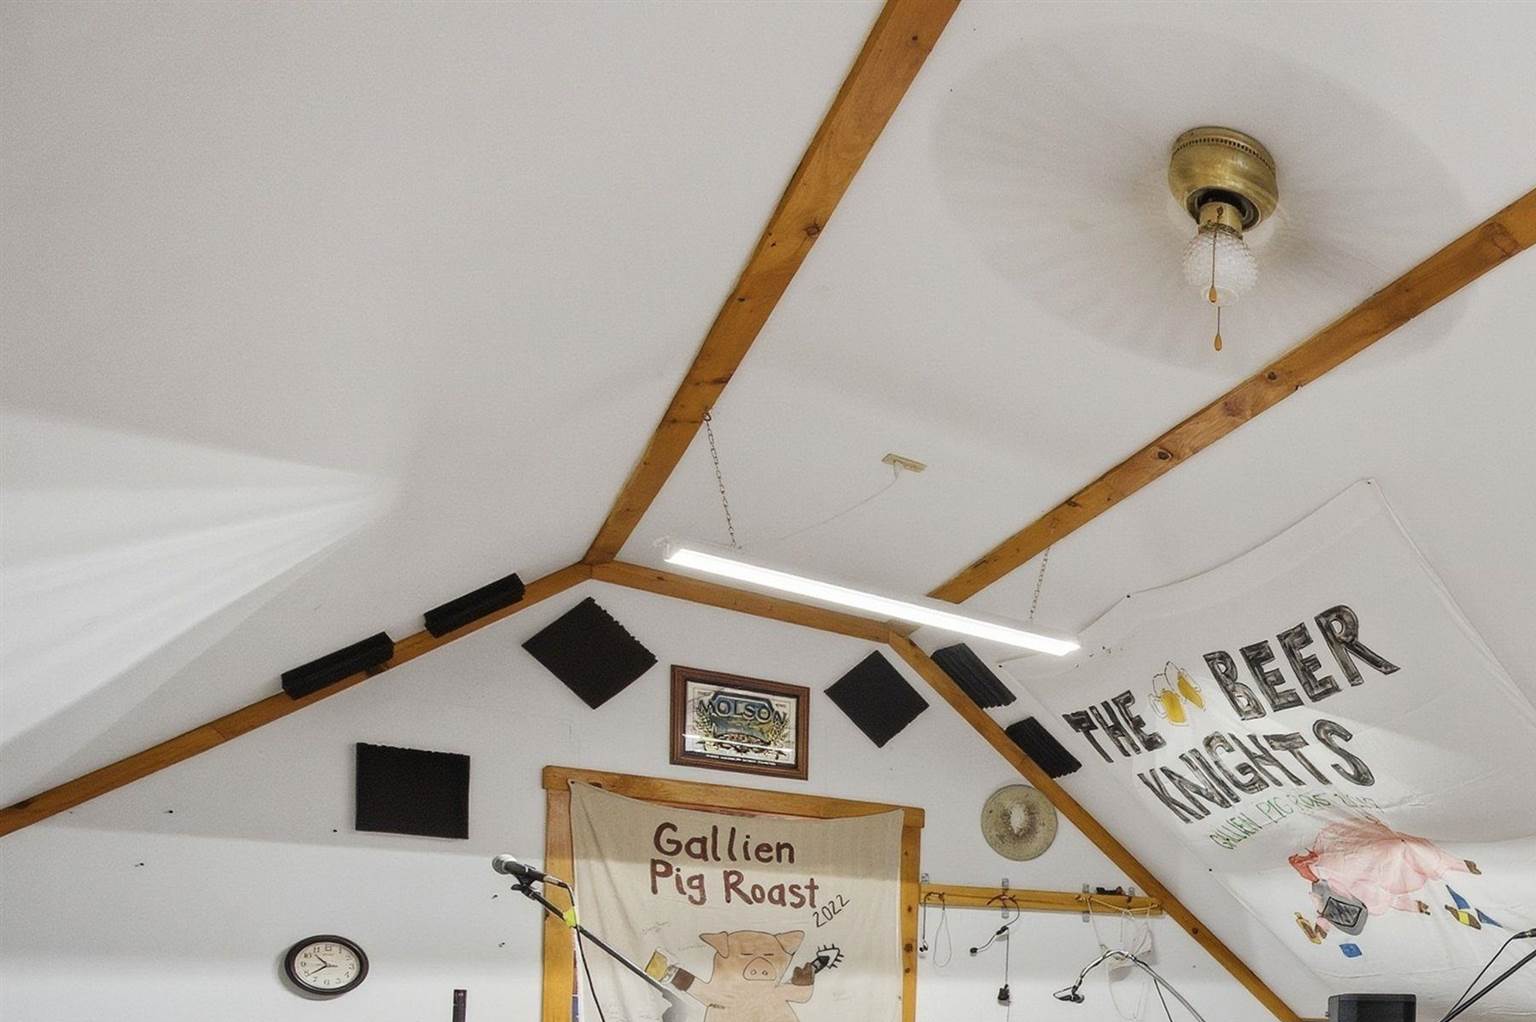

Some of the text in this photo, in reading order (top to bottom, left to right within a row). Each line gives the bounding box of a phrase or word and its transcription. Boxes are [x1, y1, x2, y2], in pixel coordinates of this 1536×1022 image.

[1062, 605, 1401, 763] THE BEER
[696, 698, 788, 726] MOLSON
[1137, 719, 1375, 824] KNIGHTS
[653, 822, 795, 864] Gallien
[650, 858, 819, 909] Pig Roast
[812, 894, 850, 928] 2022
